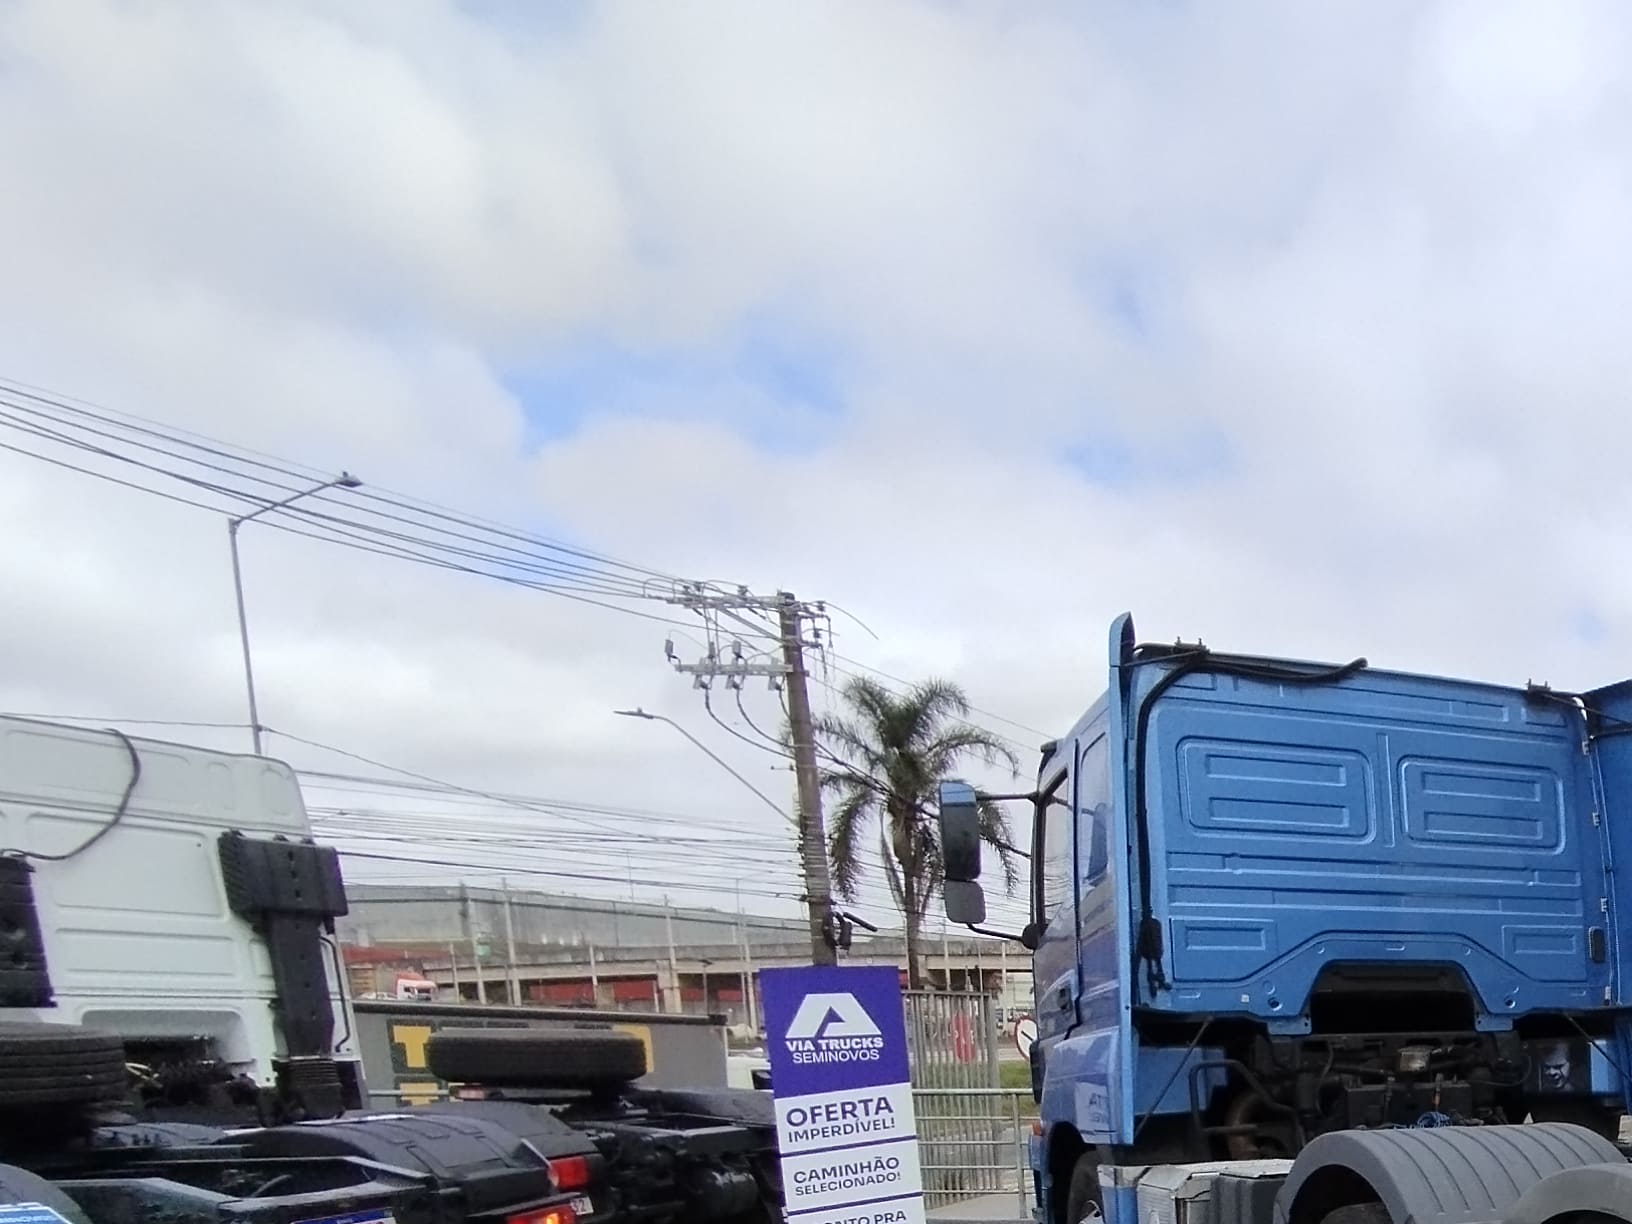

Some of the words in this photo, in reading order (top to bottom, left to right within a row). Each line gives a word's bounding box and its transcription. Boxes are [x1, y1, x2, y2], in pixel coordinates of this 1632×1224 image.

[785, 1039, 816, 1053] VIA
[818, 1036, 885, 1051] TRUCKS
[792, 1048, 881, 1064] SEMINOVOS
[786, 1096, 894, 1128] OFERTA
[788, 1117, 896, 1144] IMPERDÍVEL!
[793, 1156, 900, 1184] CAMINHÃO
[795, 1171, 902, 1197] SELECIONADO!
